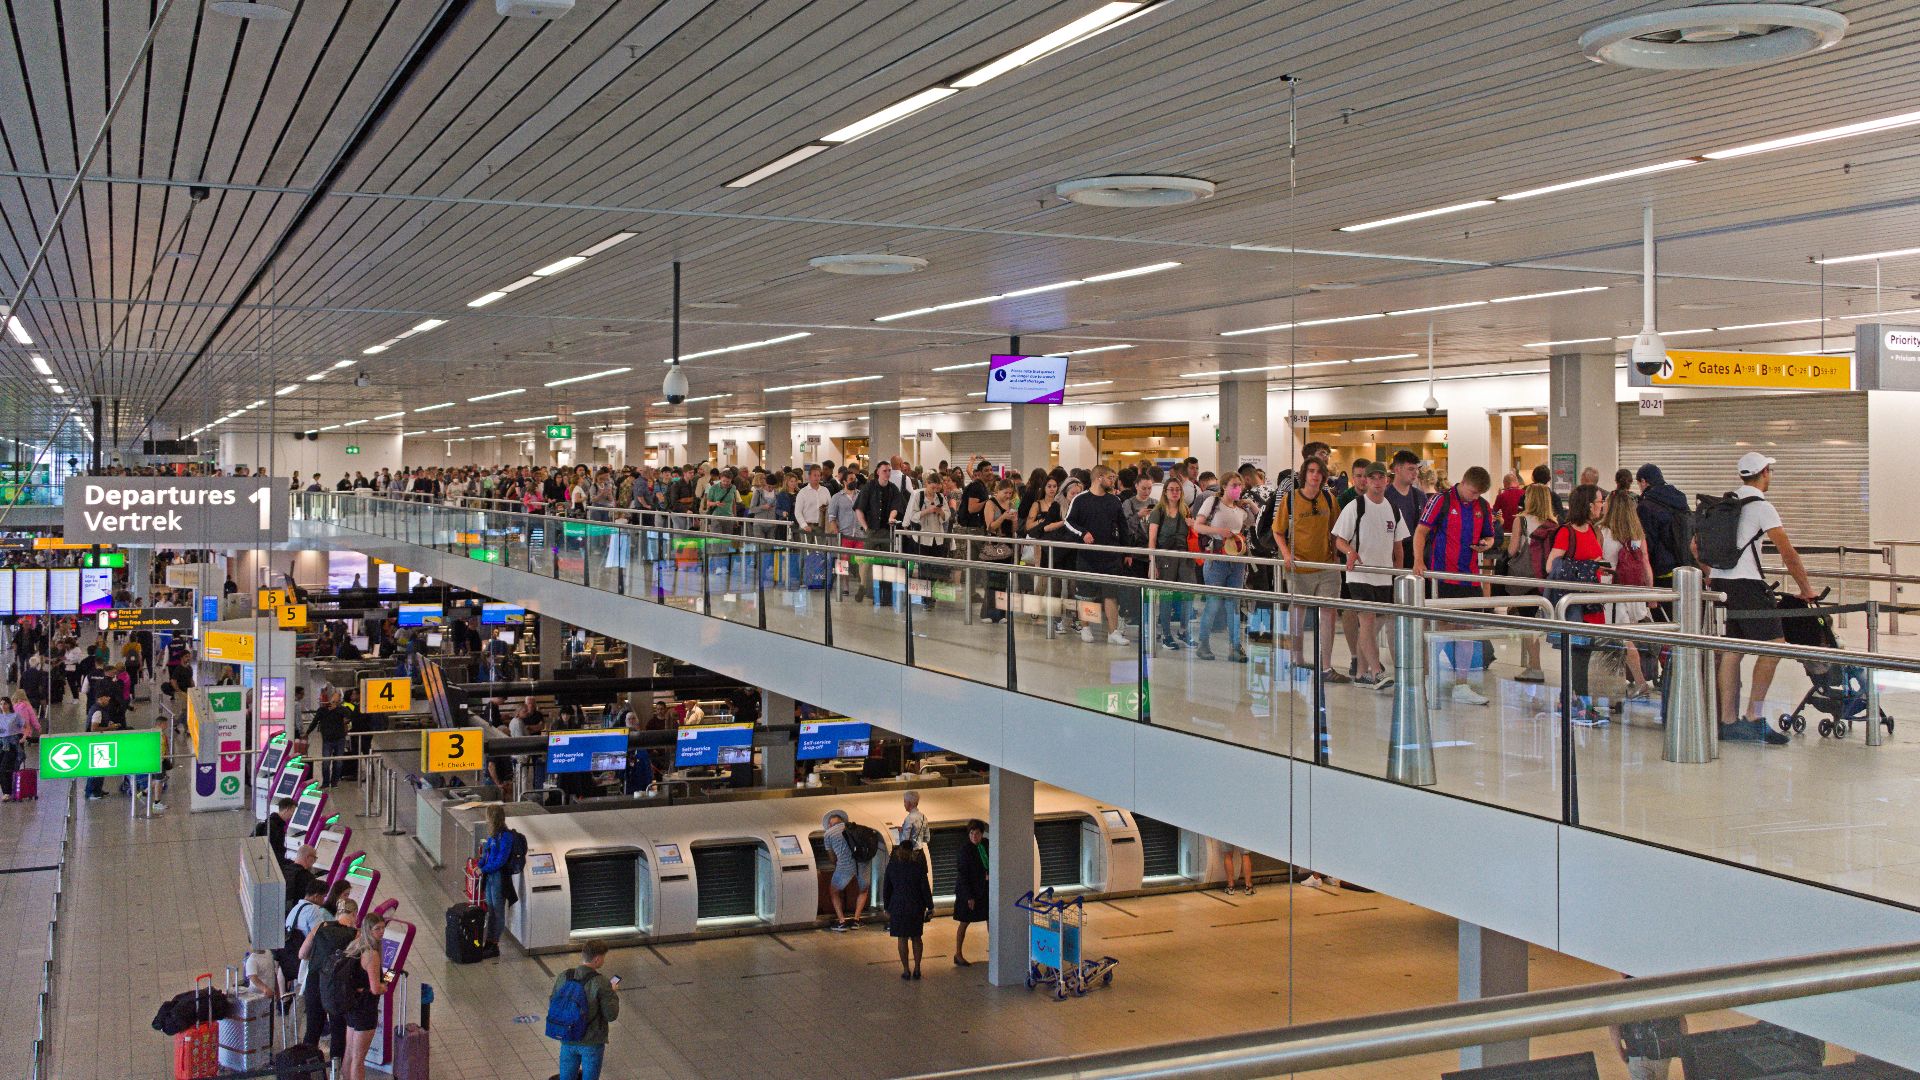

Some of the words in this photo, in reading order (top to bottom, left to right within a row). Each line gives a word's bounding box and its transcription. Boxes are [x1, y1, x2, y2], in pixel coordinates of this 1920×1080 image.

[1698, 362, 1730, 374] Gates
[1641, 400, 1662, 408] 20-21
[85, 485, 236, 510] Departures
[248, 487, 270, 530] 1
[84, 510, 182, 532] Vertrek
[288, 607, 295, 620] 5
[380, 682, 394, 701] 4
[448, 734, 464, 759] 3
